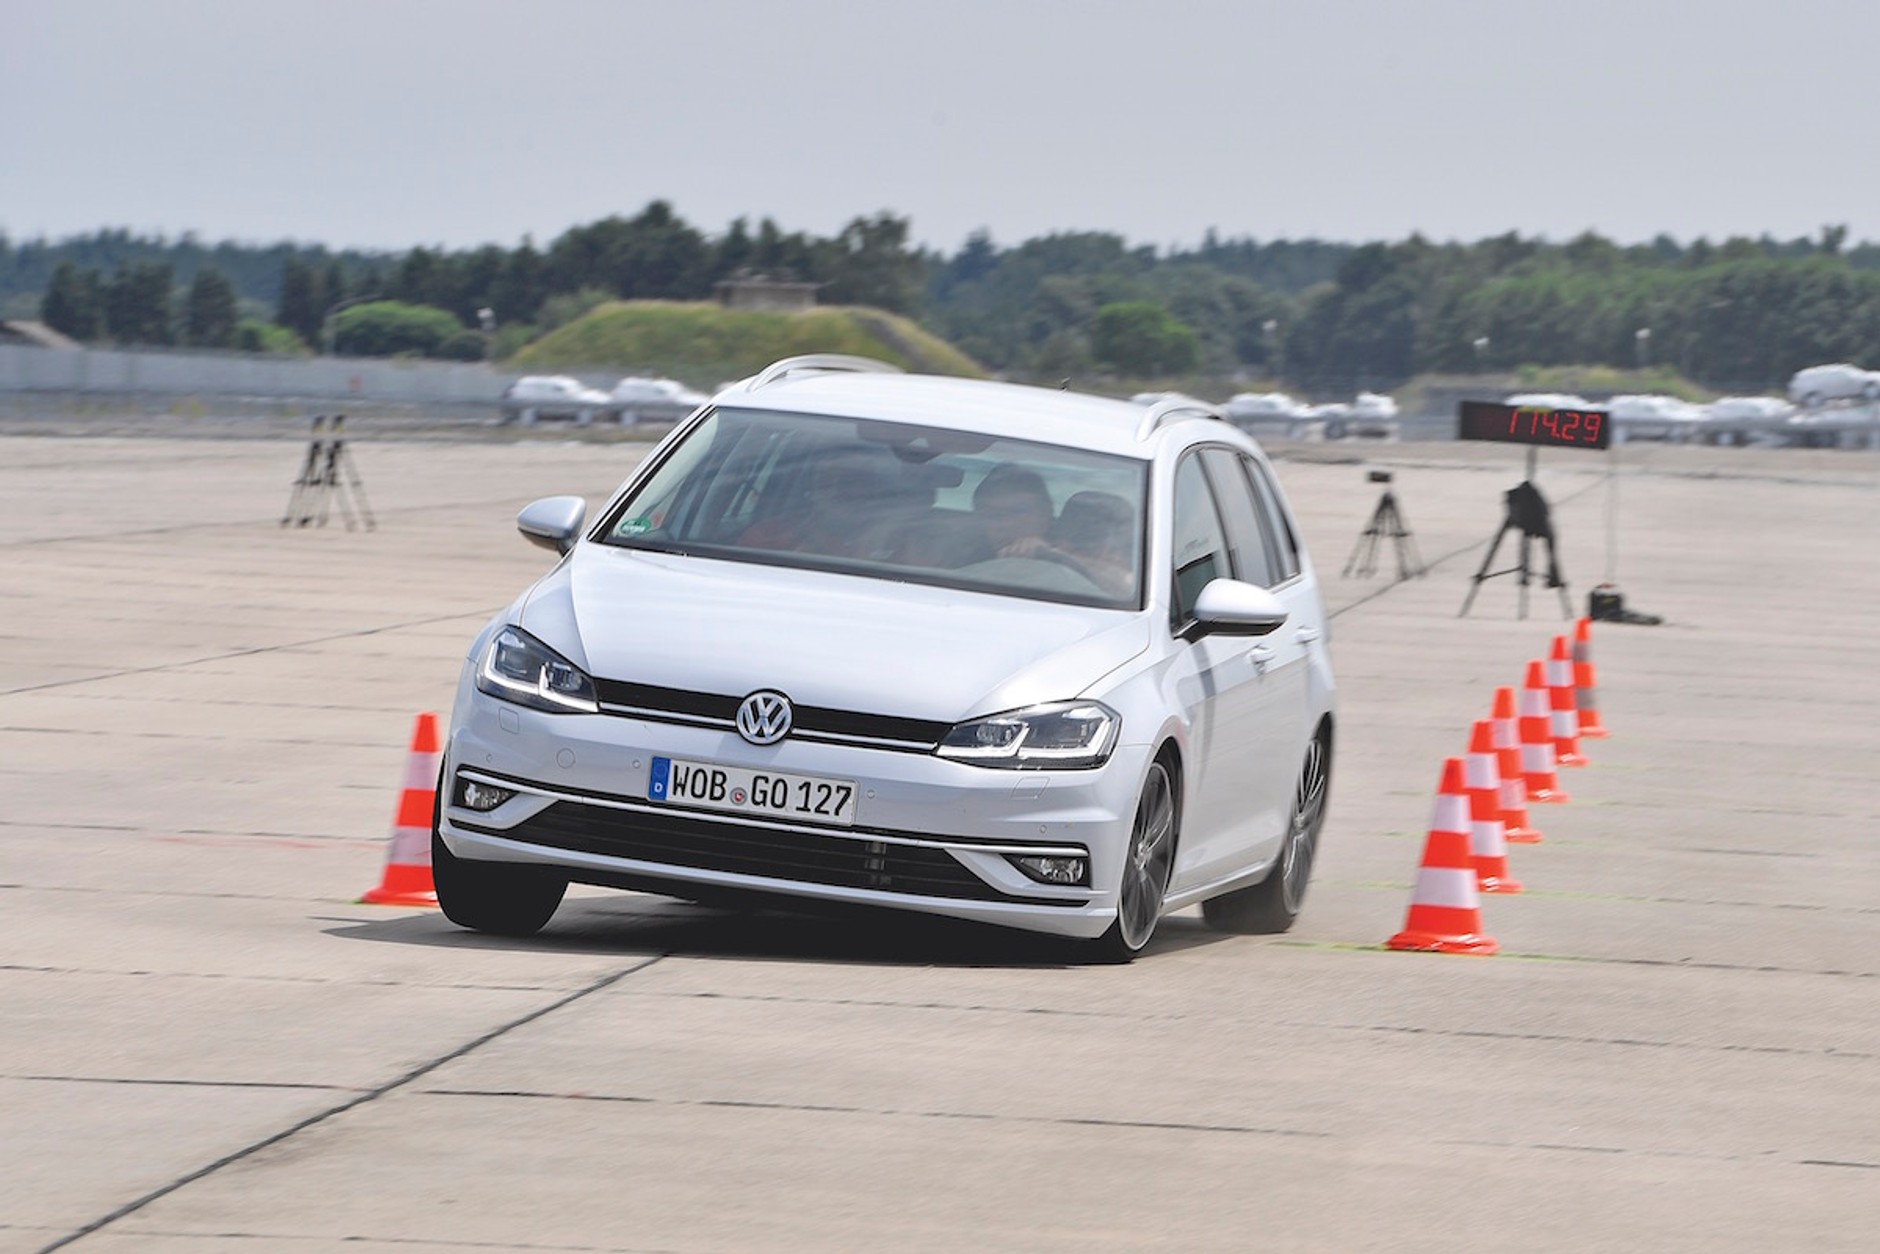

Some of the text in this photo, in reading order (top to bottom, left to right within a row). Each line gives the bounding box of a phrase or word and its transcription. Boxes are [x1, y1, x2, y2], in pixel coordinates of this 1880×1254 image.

[738, 692, 791, 742] VW
[654, 783, 663, 793] D
[672, 764, 852, 816] WOB GO 127
